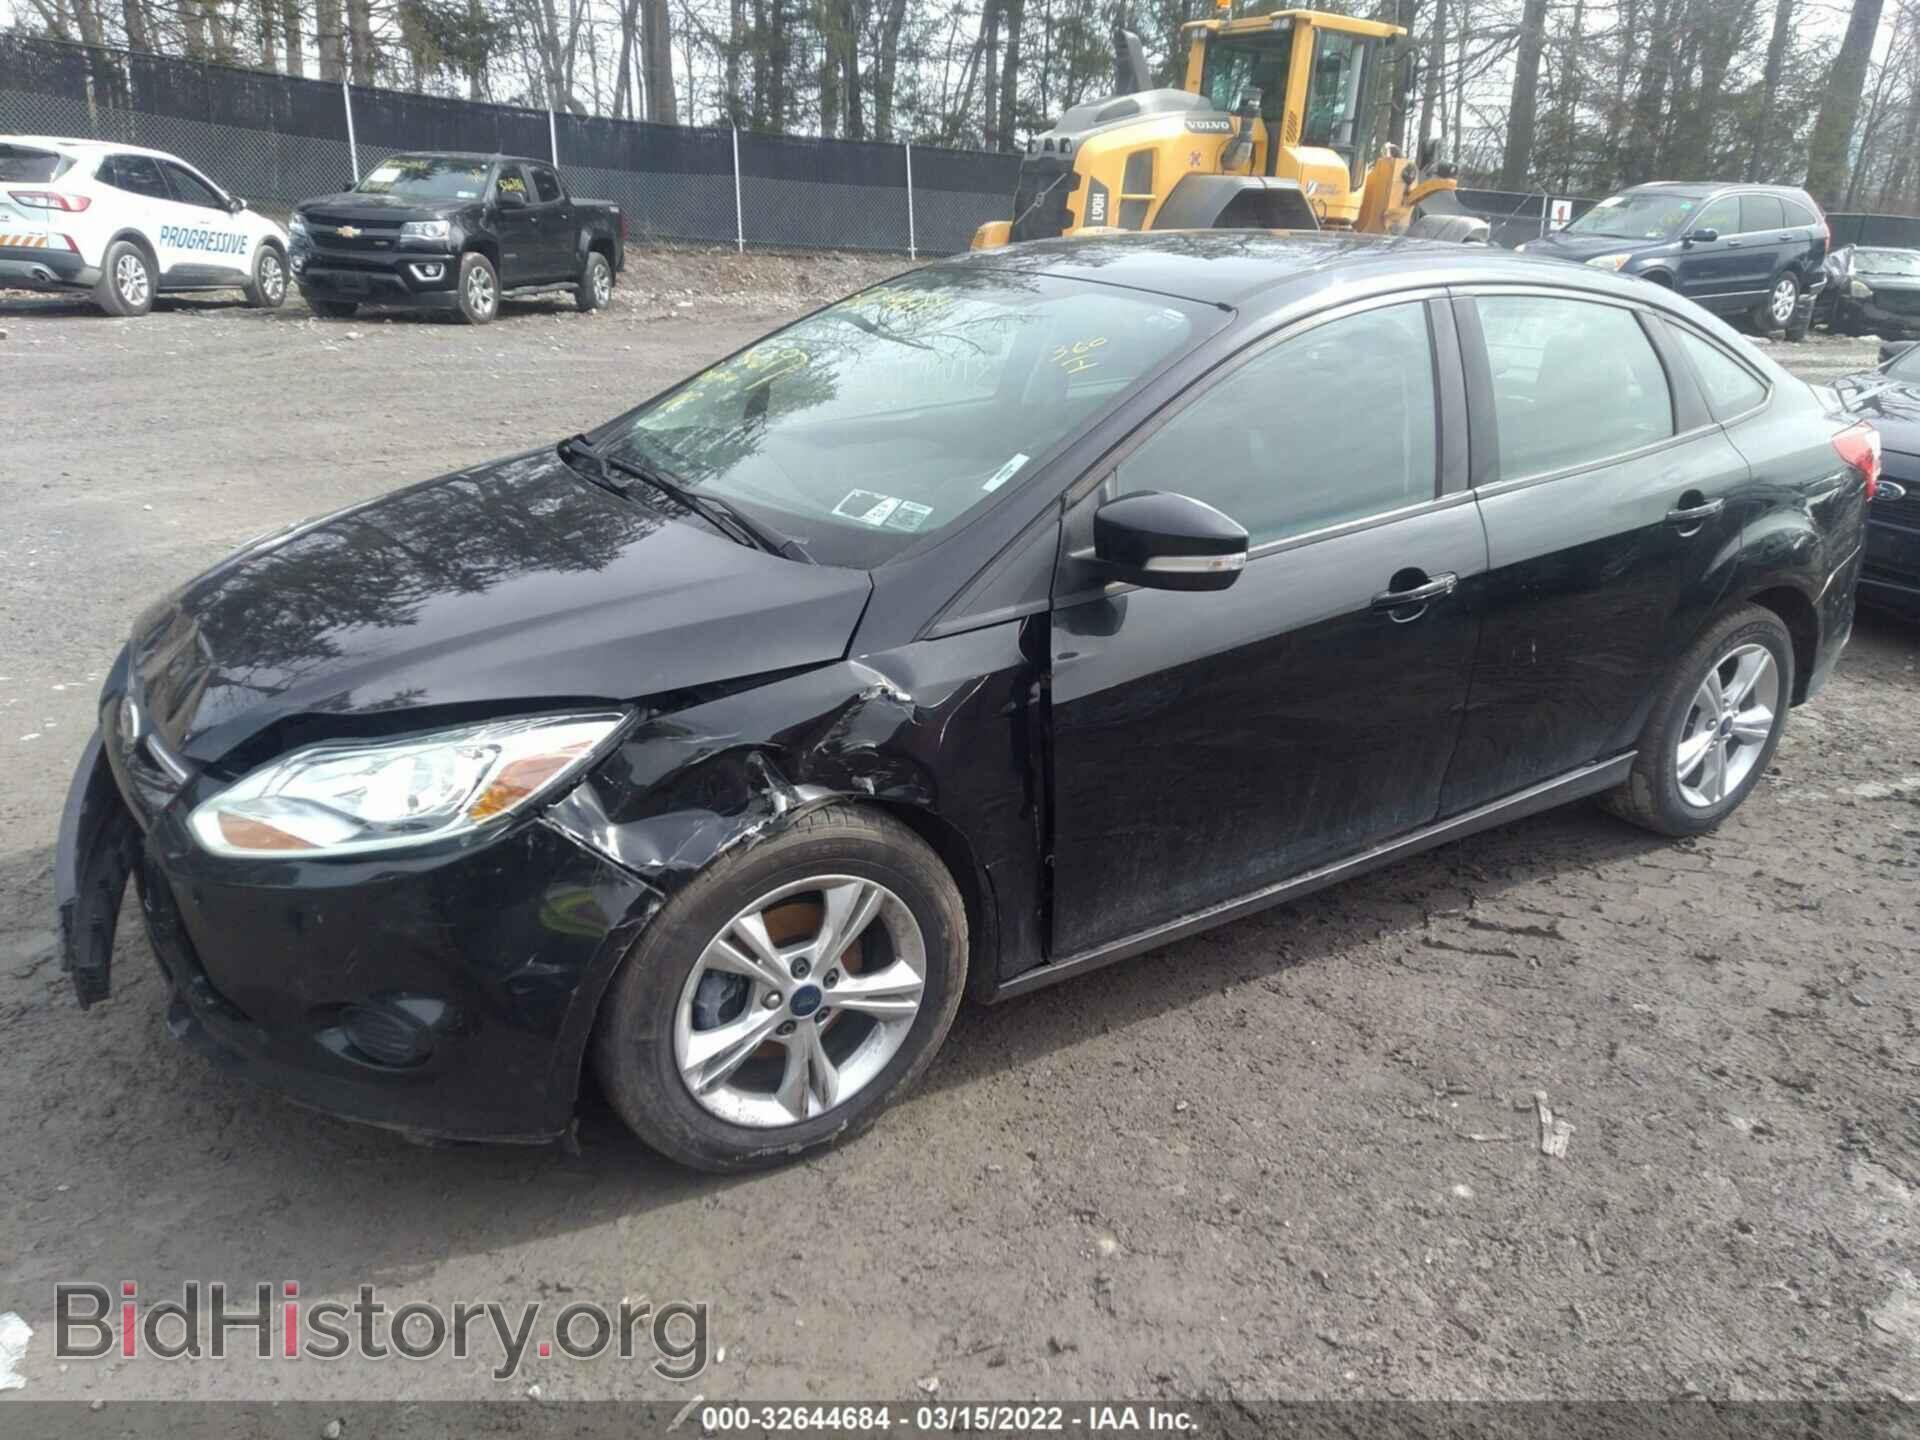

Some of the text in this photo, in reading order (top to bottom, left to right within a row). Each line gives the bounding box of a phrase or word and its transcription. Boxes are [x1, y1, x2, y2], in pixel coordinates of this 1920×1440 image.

[1187, 120, 1230, 129] VOLVO
[1091, 193, 1105, 220] L90H
[160, 225, 248, 255] PROGRESSIVE
